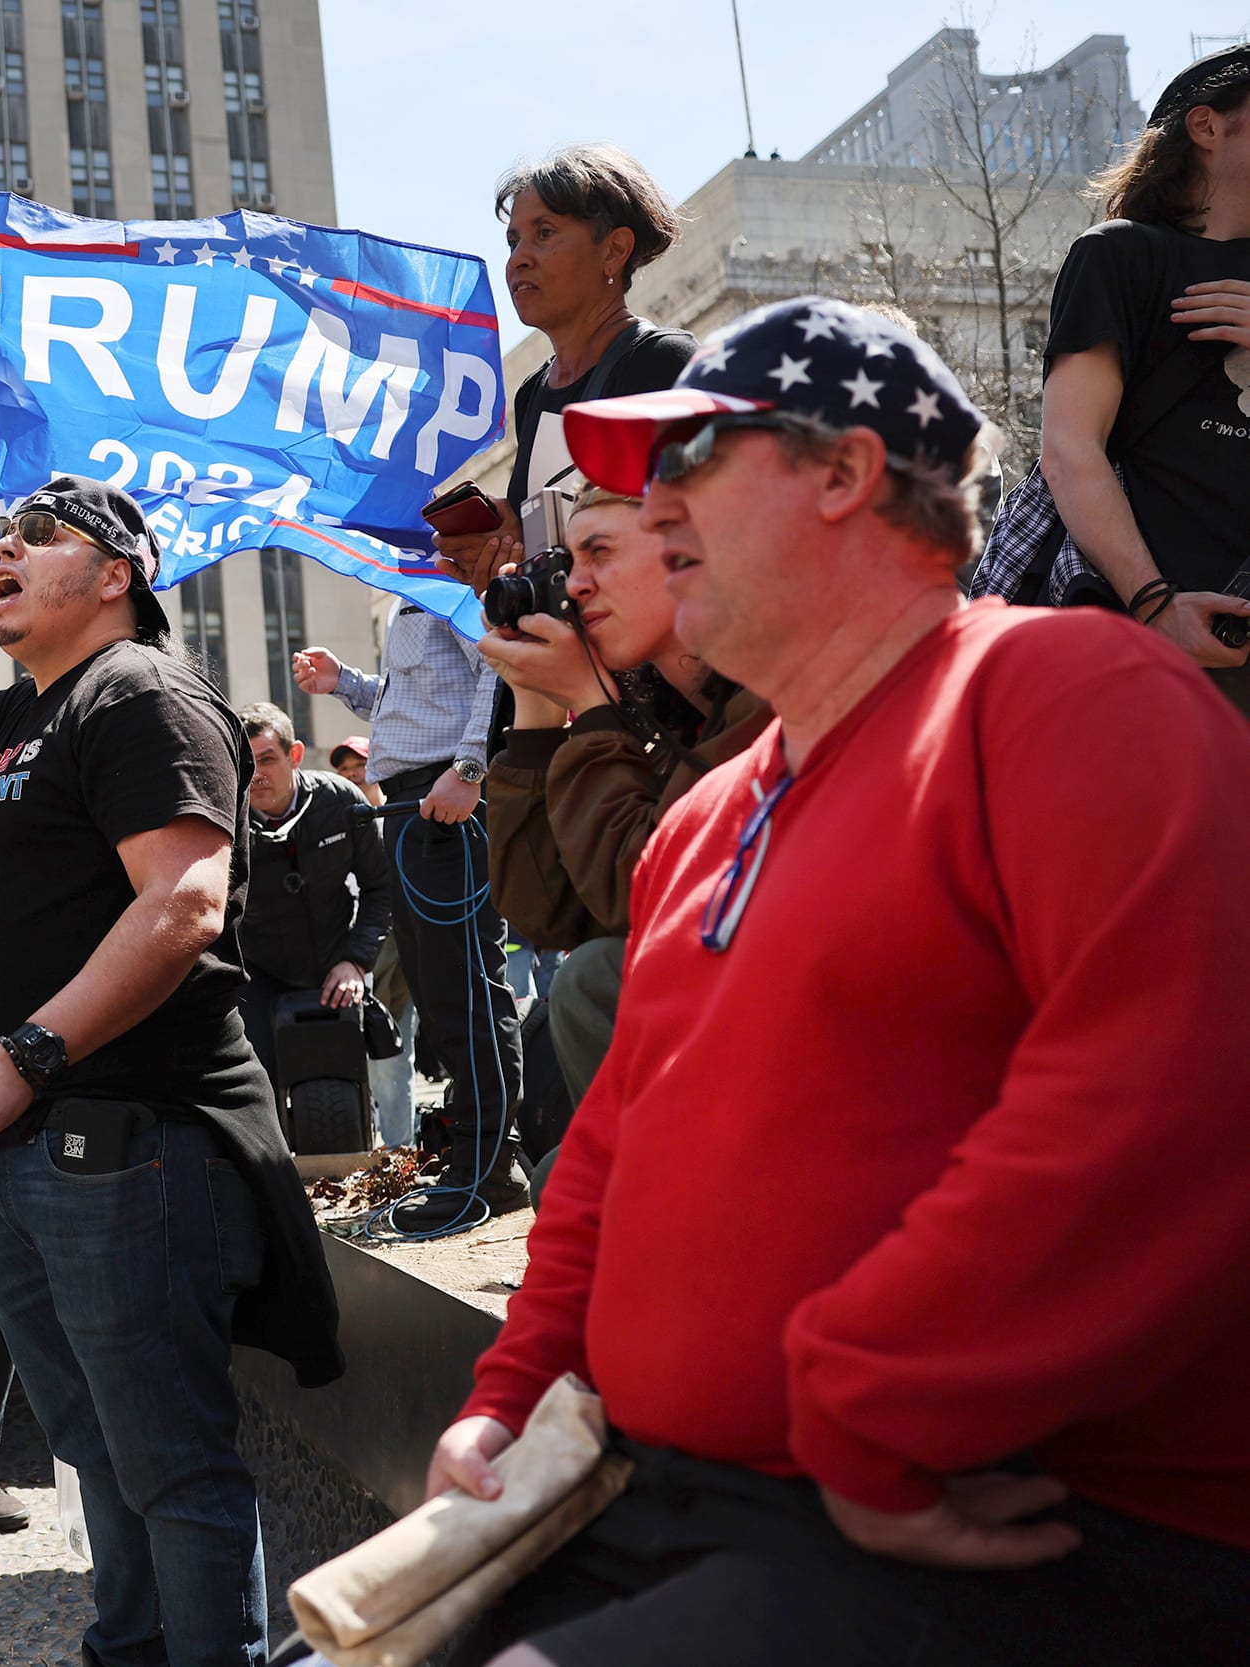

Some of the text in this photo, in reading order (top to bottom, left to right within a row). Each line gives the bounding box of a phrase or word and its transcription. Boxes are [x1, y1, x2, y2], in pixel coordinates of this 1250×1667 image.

[1200, 419, 1250, 438] C'MO
[88, 438, 312, 519] 2024
[64, 500, 119, 538] TRUMP#45
